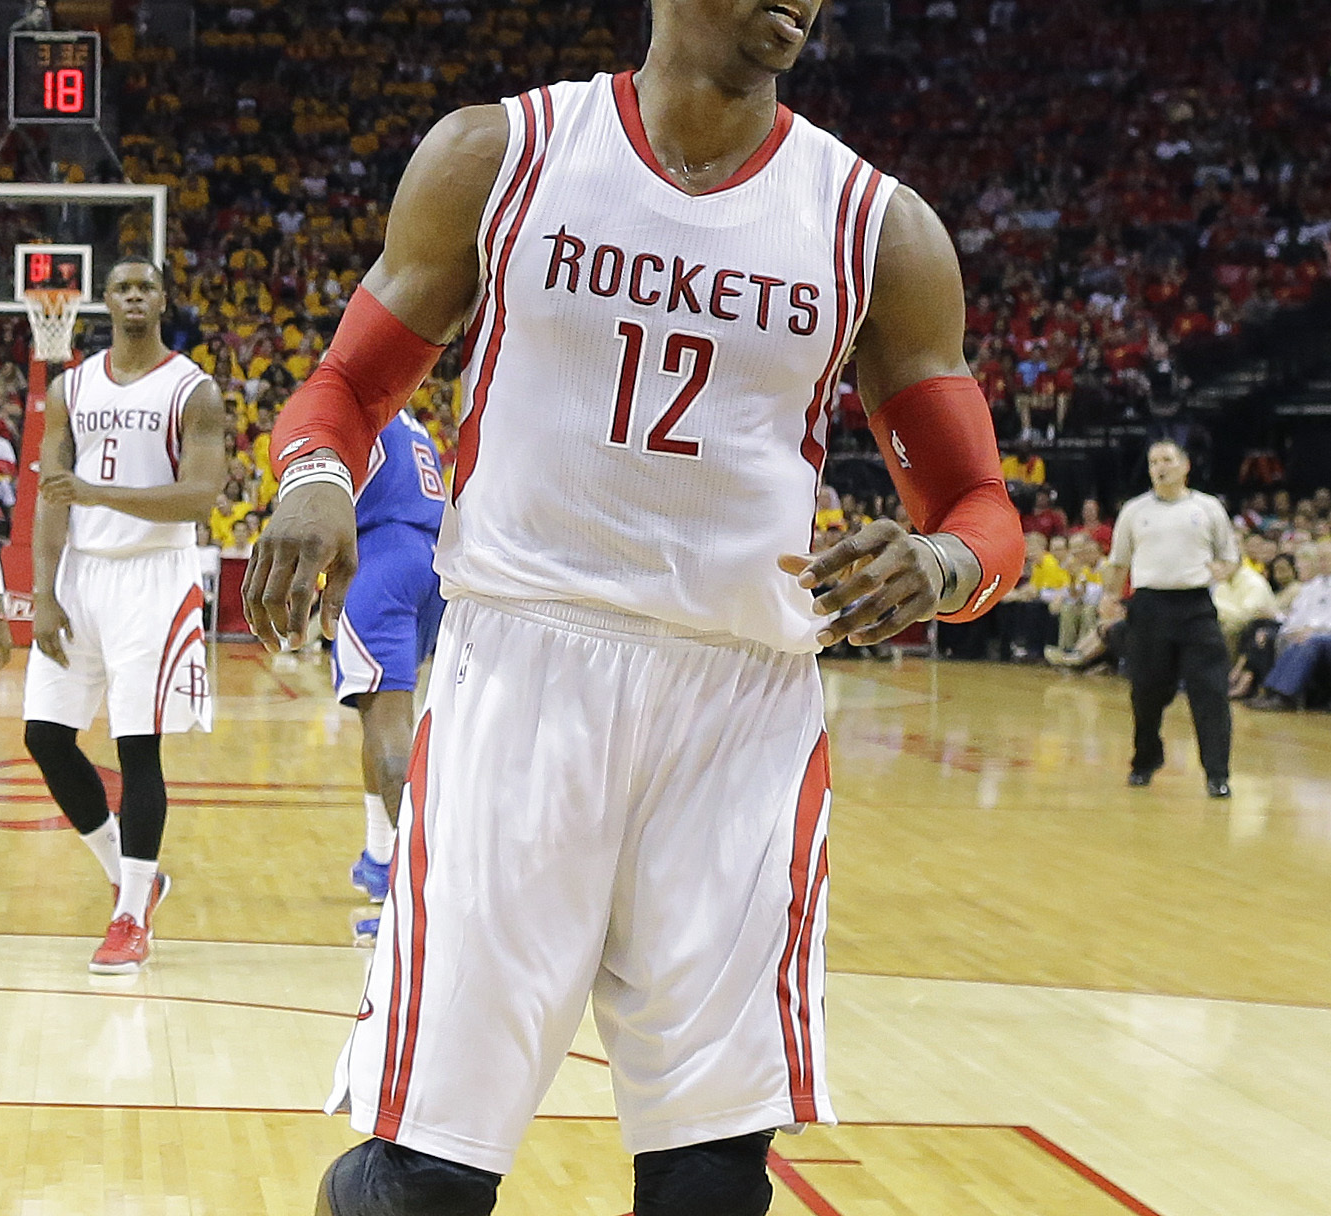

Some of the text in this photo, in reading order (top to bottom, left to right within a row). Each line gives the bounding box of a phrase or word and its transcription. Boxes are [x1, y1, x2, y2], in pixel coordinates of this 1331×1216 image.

[43, 68, 85, 113] 18
[542, 224, 820, 337] ROCKETS
[604, 316, 719, 461] 12
[75, 408, 162, 434] ROCKETS
[100, 436, 119, 482] 6
